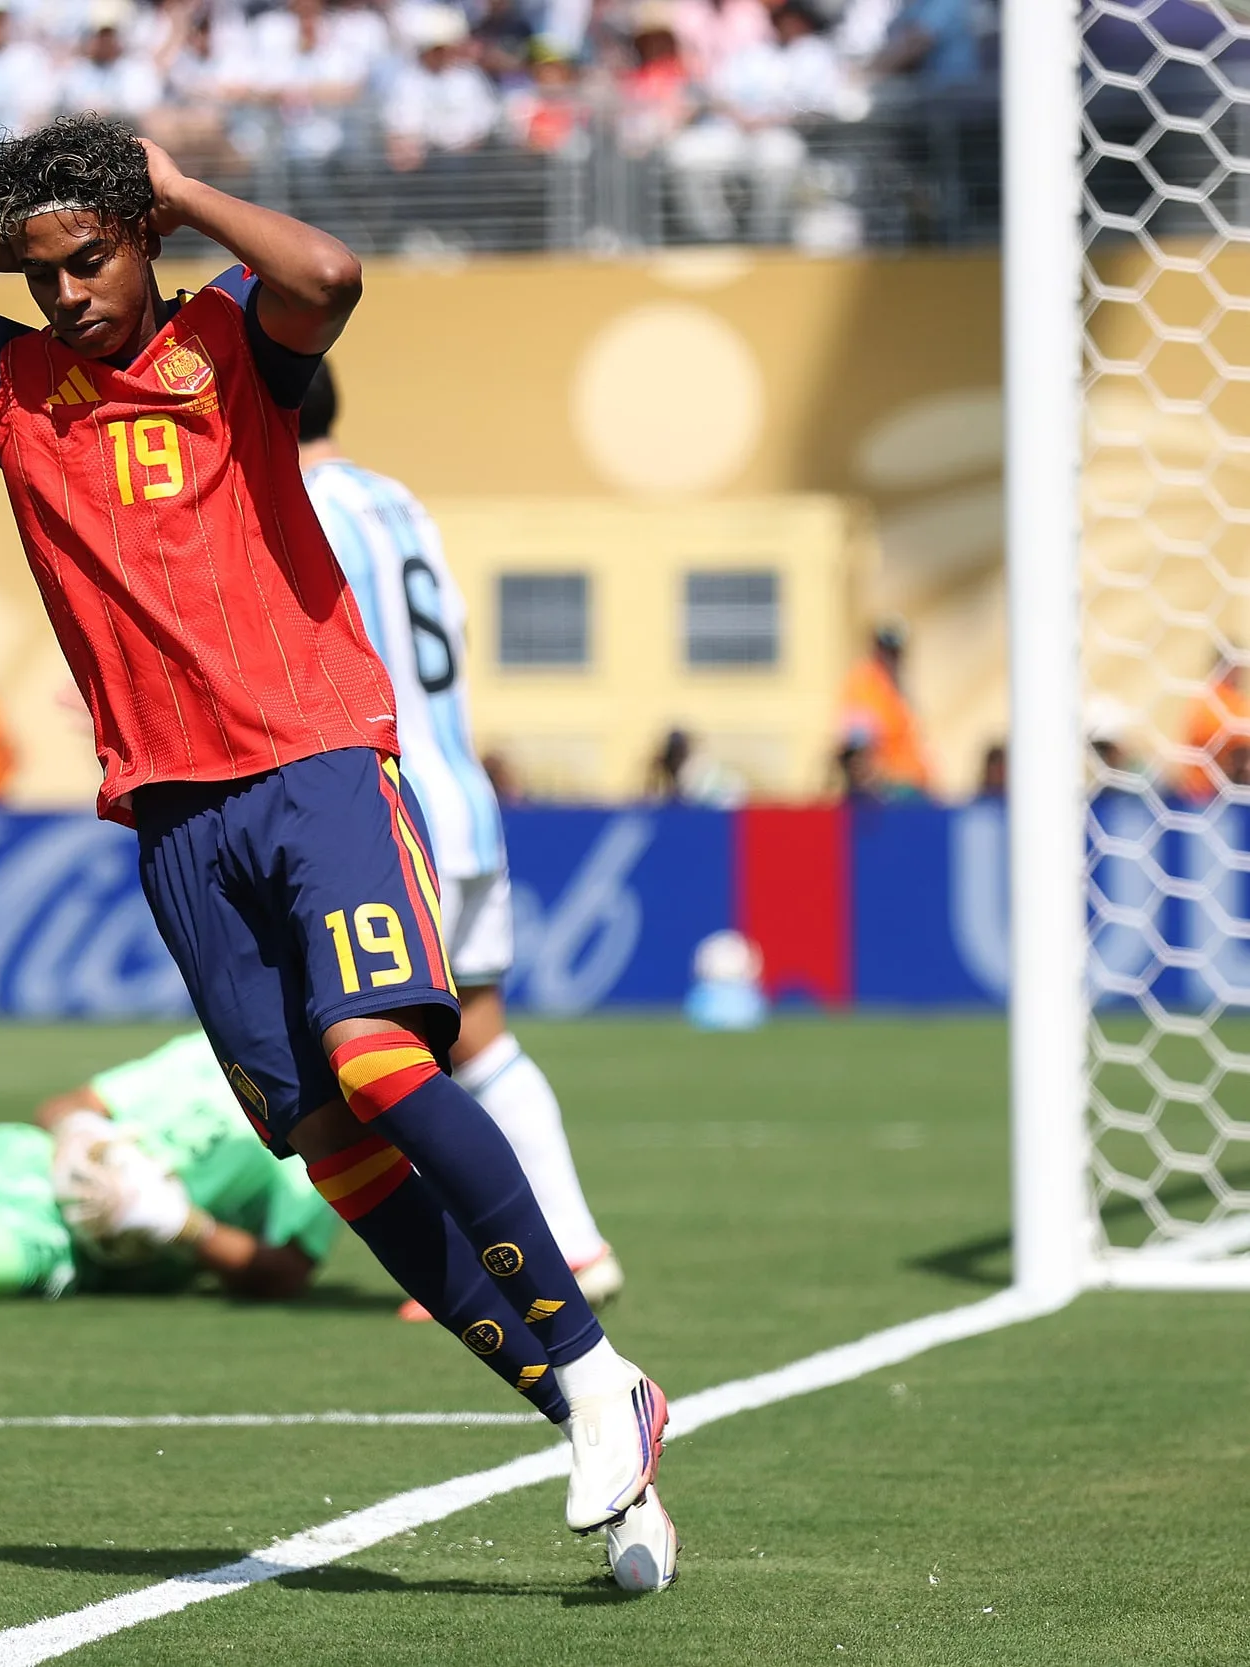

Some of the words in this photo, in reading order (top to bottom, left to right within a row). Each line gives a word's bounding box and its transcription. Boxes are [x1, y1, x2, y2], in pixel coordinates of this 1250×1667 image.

[107, 413, 184, 506] 19
[402, 558, 454, 694] 6
[324, 902, 413, 994] 19
